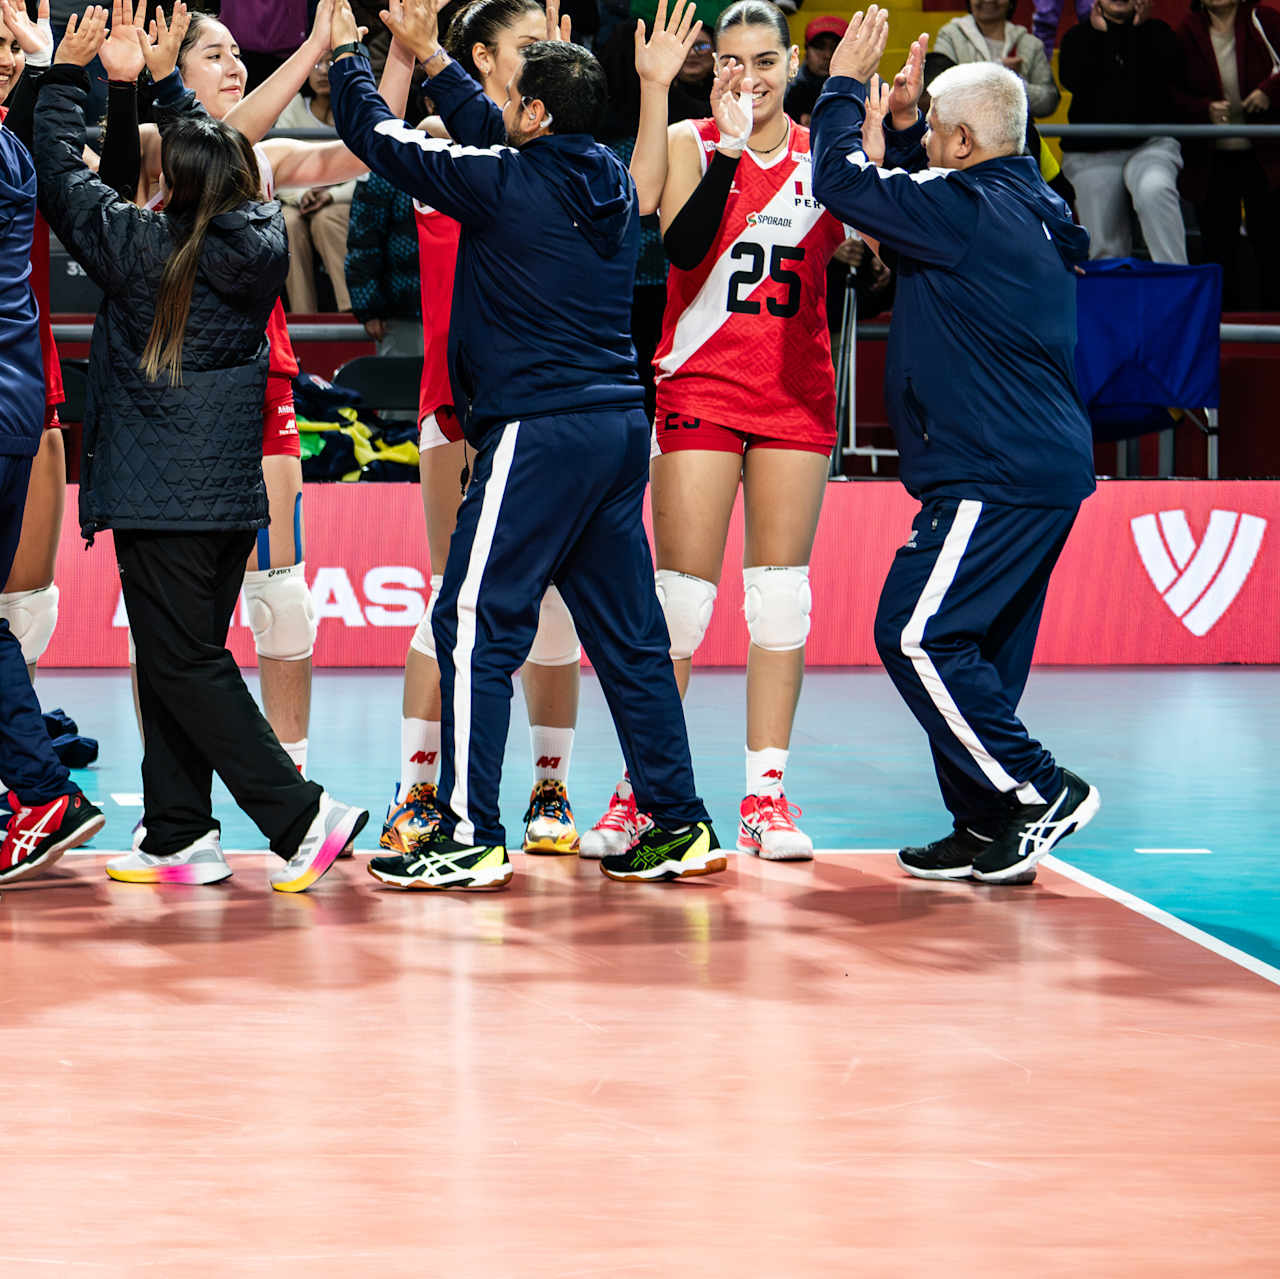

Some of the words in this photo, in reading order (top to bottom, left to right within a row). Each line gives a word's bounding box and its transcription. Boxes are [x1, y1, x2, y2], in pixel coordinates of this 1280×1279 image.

[794, 198, 823, 211] PER
[757, 214, 793, 228] SPORADE
[726, 241, 806, 319] 25
